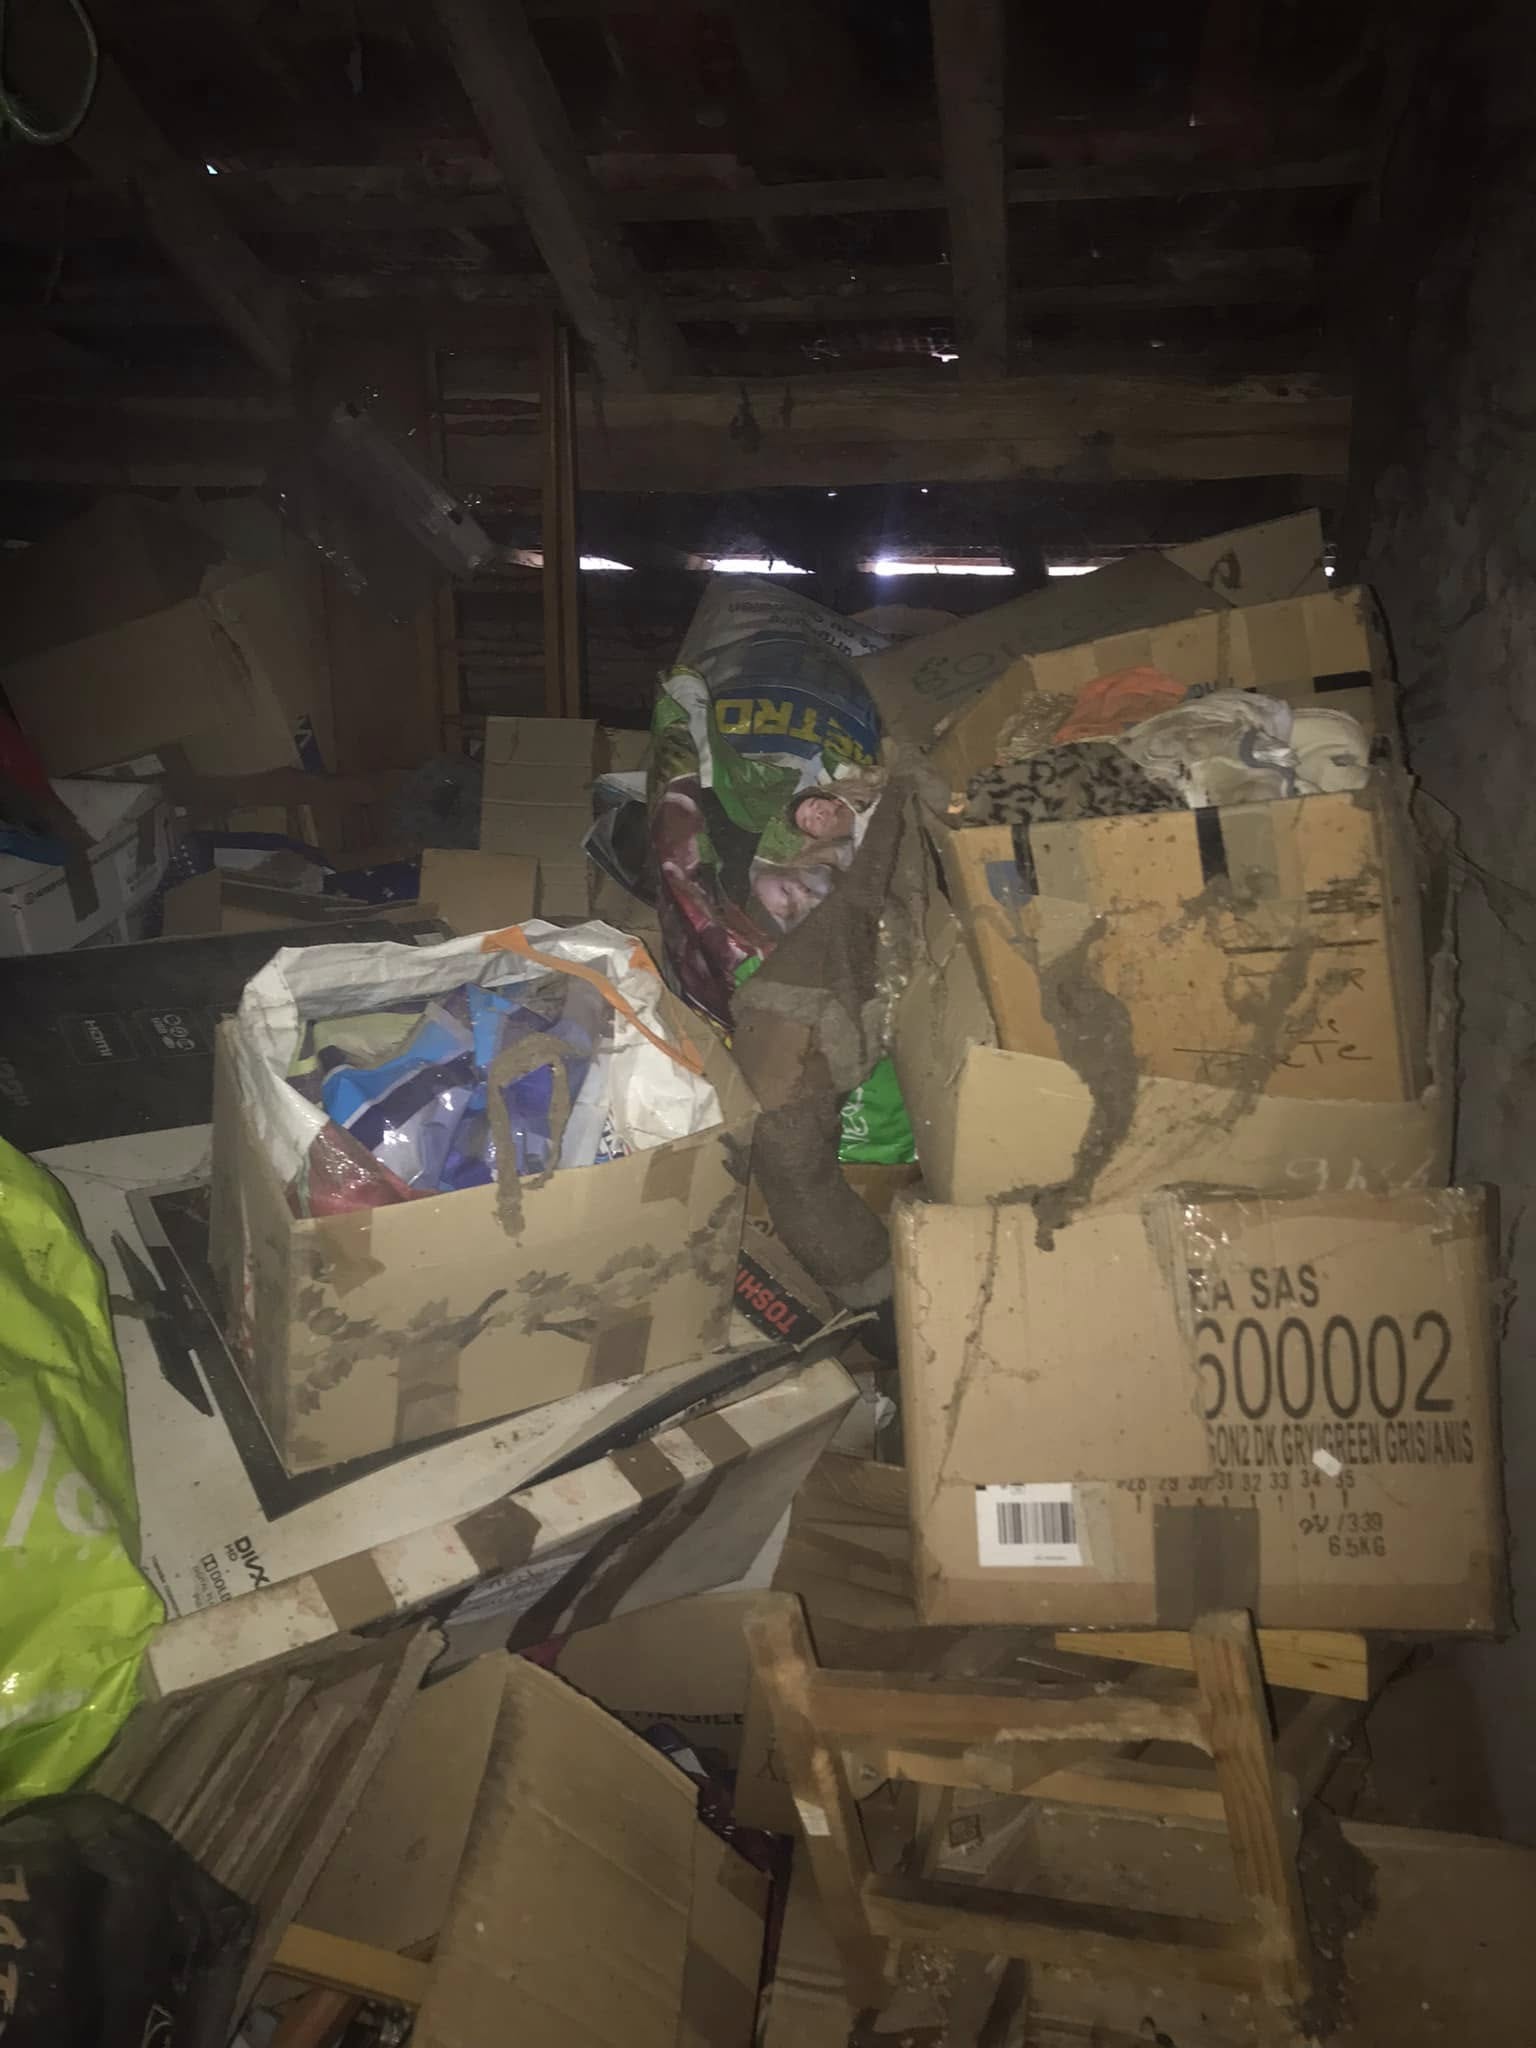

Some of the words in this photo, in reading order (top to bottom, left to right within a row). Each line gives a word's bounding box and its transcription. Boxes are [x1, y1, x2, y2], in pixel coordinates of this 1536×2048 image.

[1250, 1264, 1319, 1310] SAS
[1254, 1424, 1278, 1466] DK
[1241, 1471, 1262, 1492] 32
[1269, 1471, 1289, 1490] 33
[1300, 1469, 1321, 1488] 34
[233, 1536, 270, 1586] DIVX
